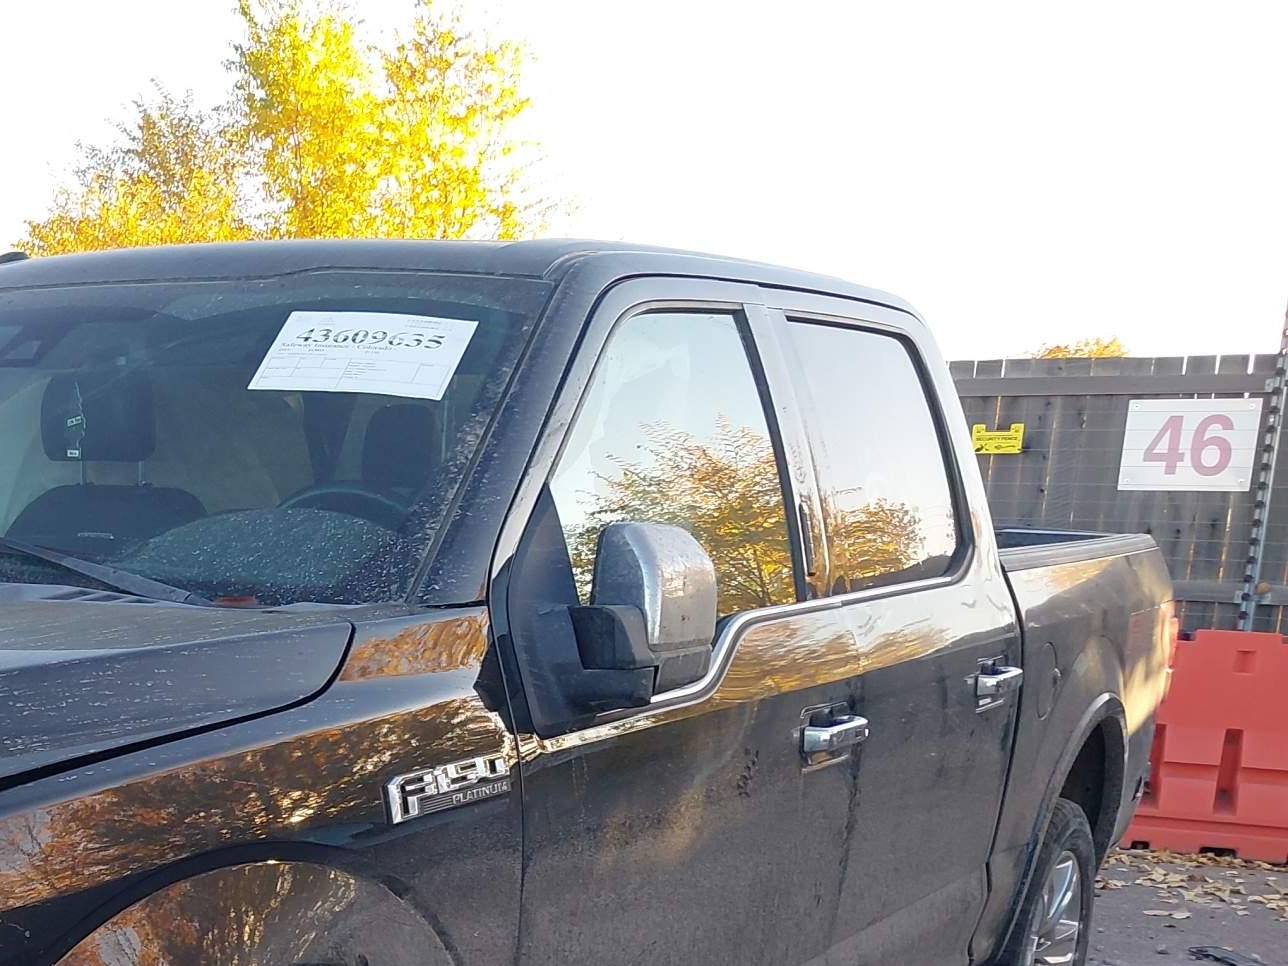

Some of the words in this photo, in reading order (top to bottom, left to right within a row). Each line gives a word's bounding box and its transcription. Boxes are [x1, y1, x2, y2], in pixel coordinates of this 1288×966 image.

[296, 328, 446, 350] 43609635
[1143, 414, 1234, 476] 46
[452, 781, 509, 805] PLATINUM
